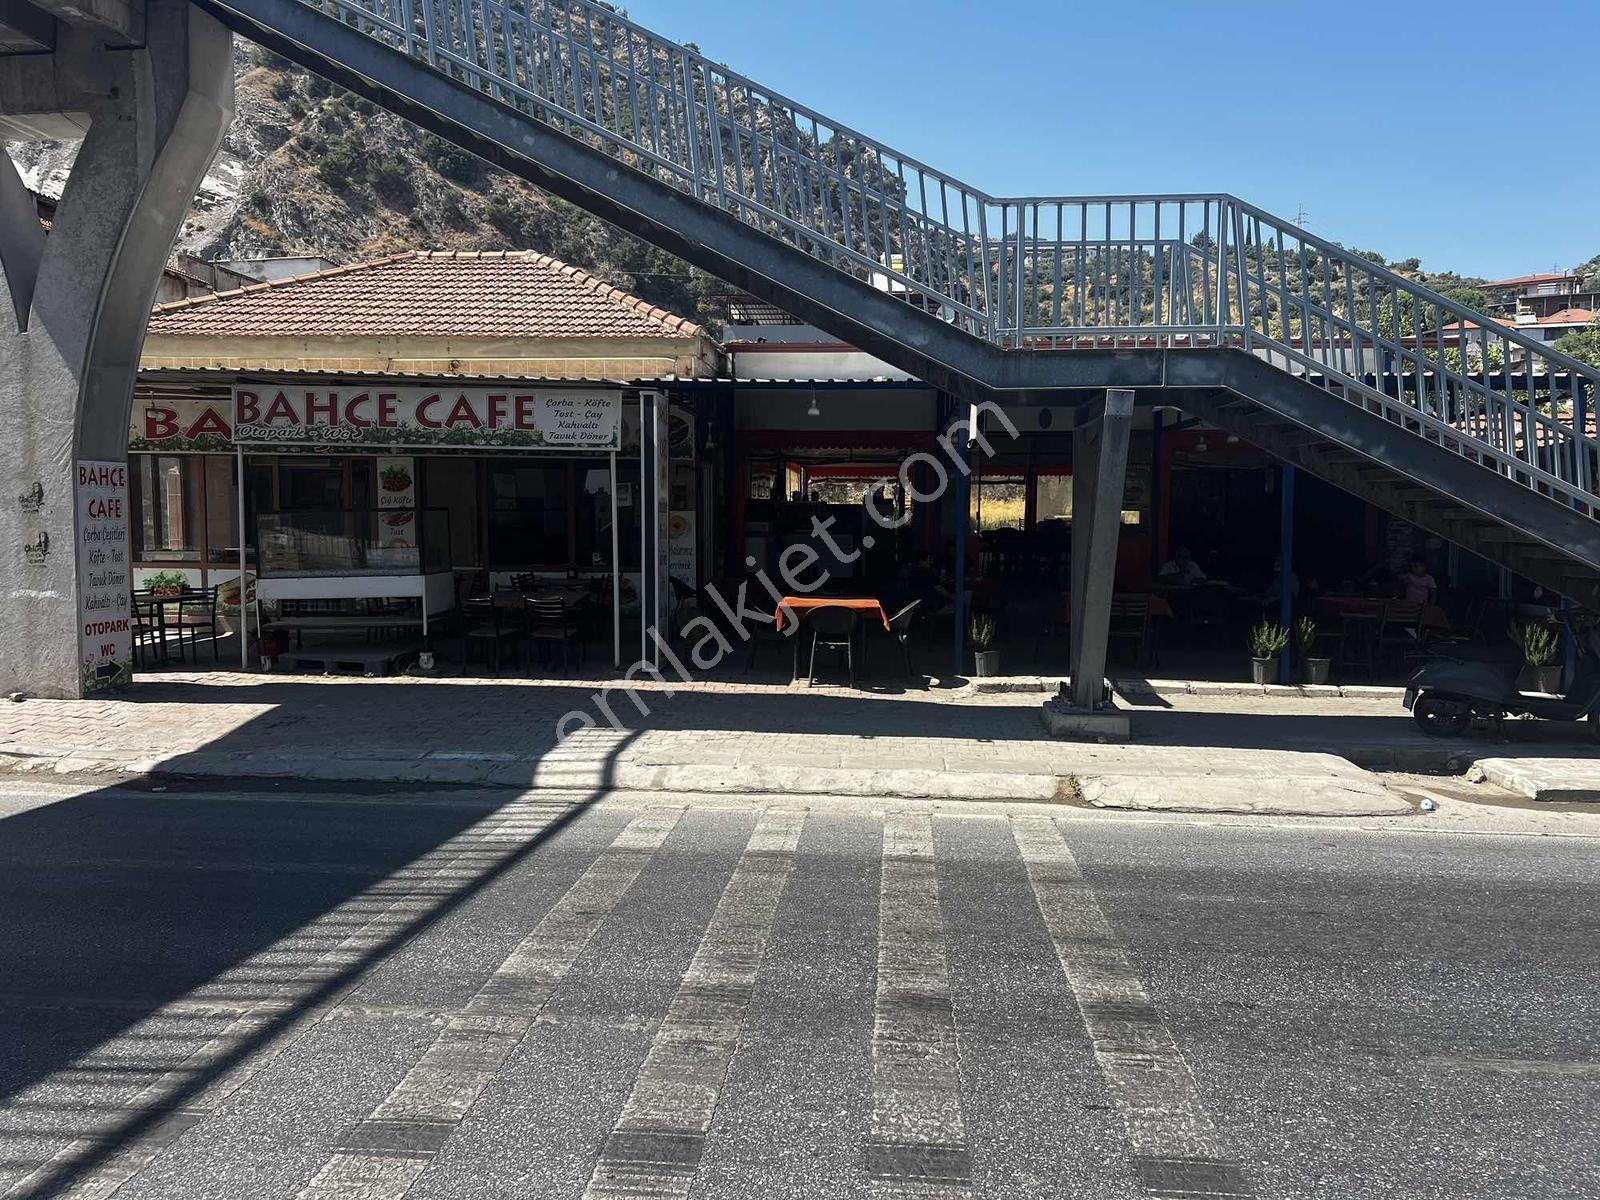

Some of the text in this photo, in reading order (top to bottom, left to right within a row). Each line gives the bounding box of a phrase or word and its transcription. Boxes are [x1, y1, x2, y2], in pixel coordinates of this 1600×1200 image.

[545, 398, 574, 408] Çorba
[584, 398, 611, 408] Köfte
[235, 389, 536, 439] BAHÇE CAFE
[553, 410, 574, 418] Tost
[584, 410, 603, 420] Çay
[239, 425, 305, 440] Otopark
[548, 432, 608, 440] Tavuk Döner
[79, 466, 125, 492] BAHÇE
[88, 498, 121, 518] CAFE
[393, 496, 412, 505] Köfte
[84, 527, 100, 545] Çorba
[89, 550, 106, 566] Köfte
[112, 549, 124, 563] Tost
[89, 571, 125, 587] Tavuk Döner
[116, 594, 128, 610] Çay
[85, 619, 130, 636] OTOPARK
[101, 644, 116, 656] WC
